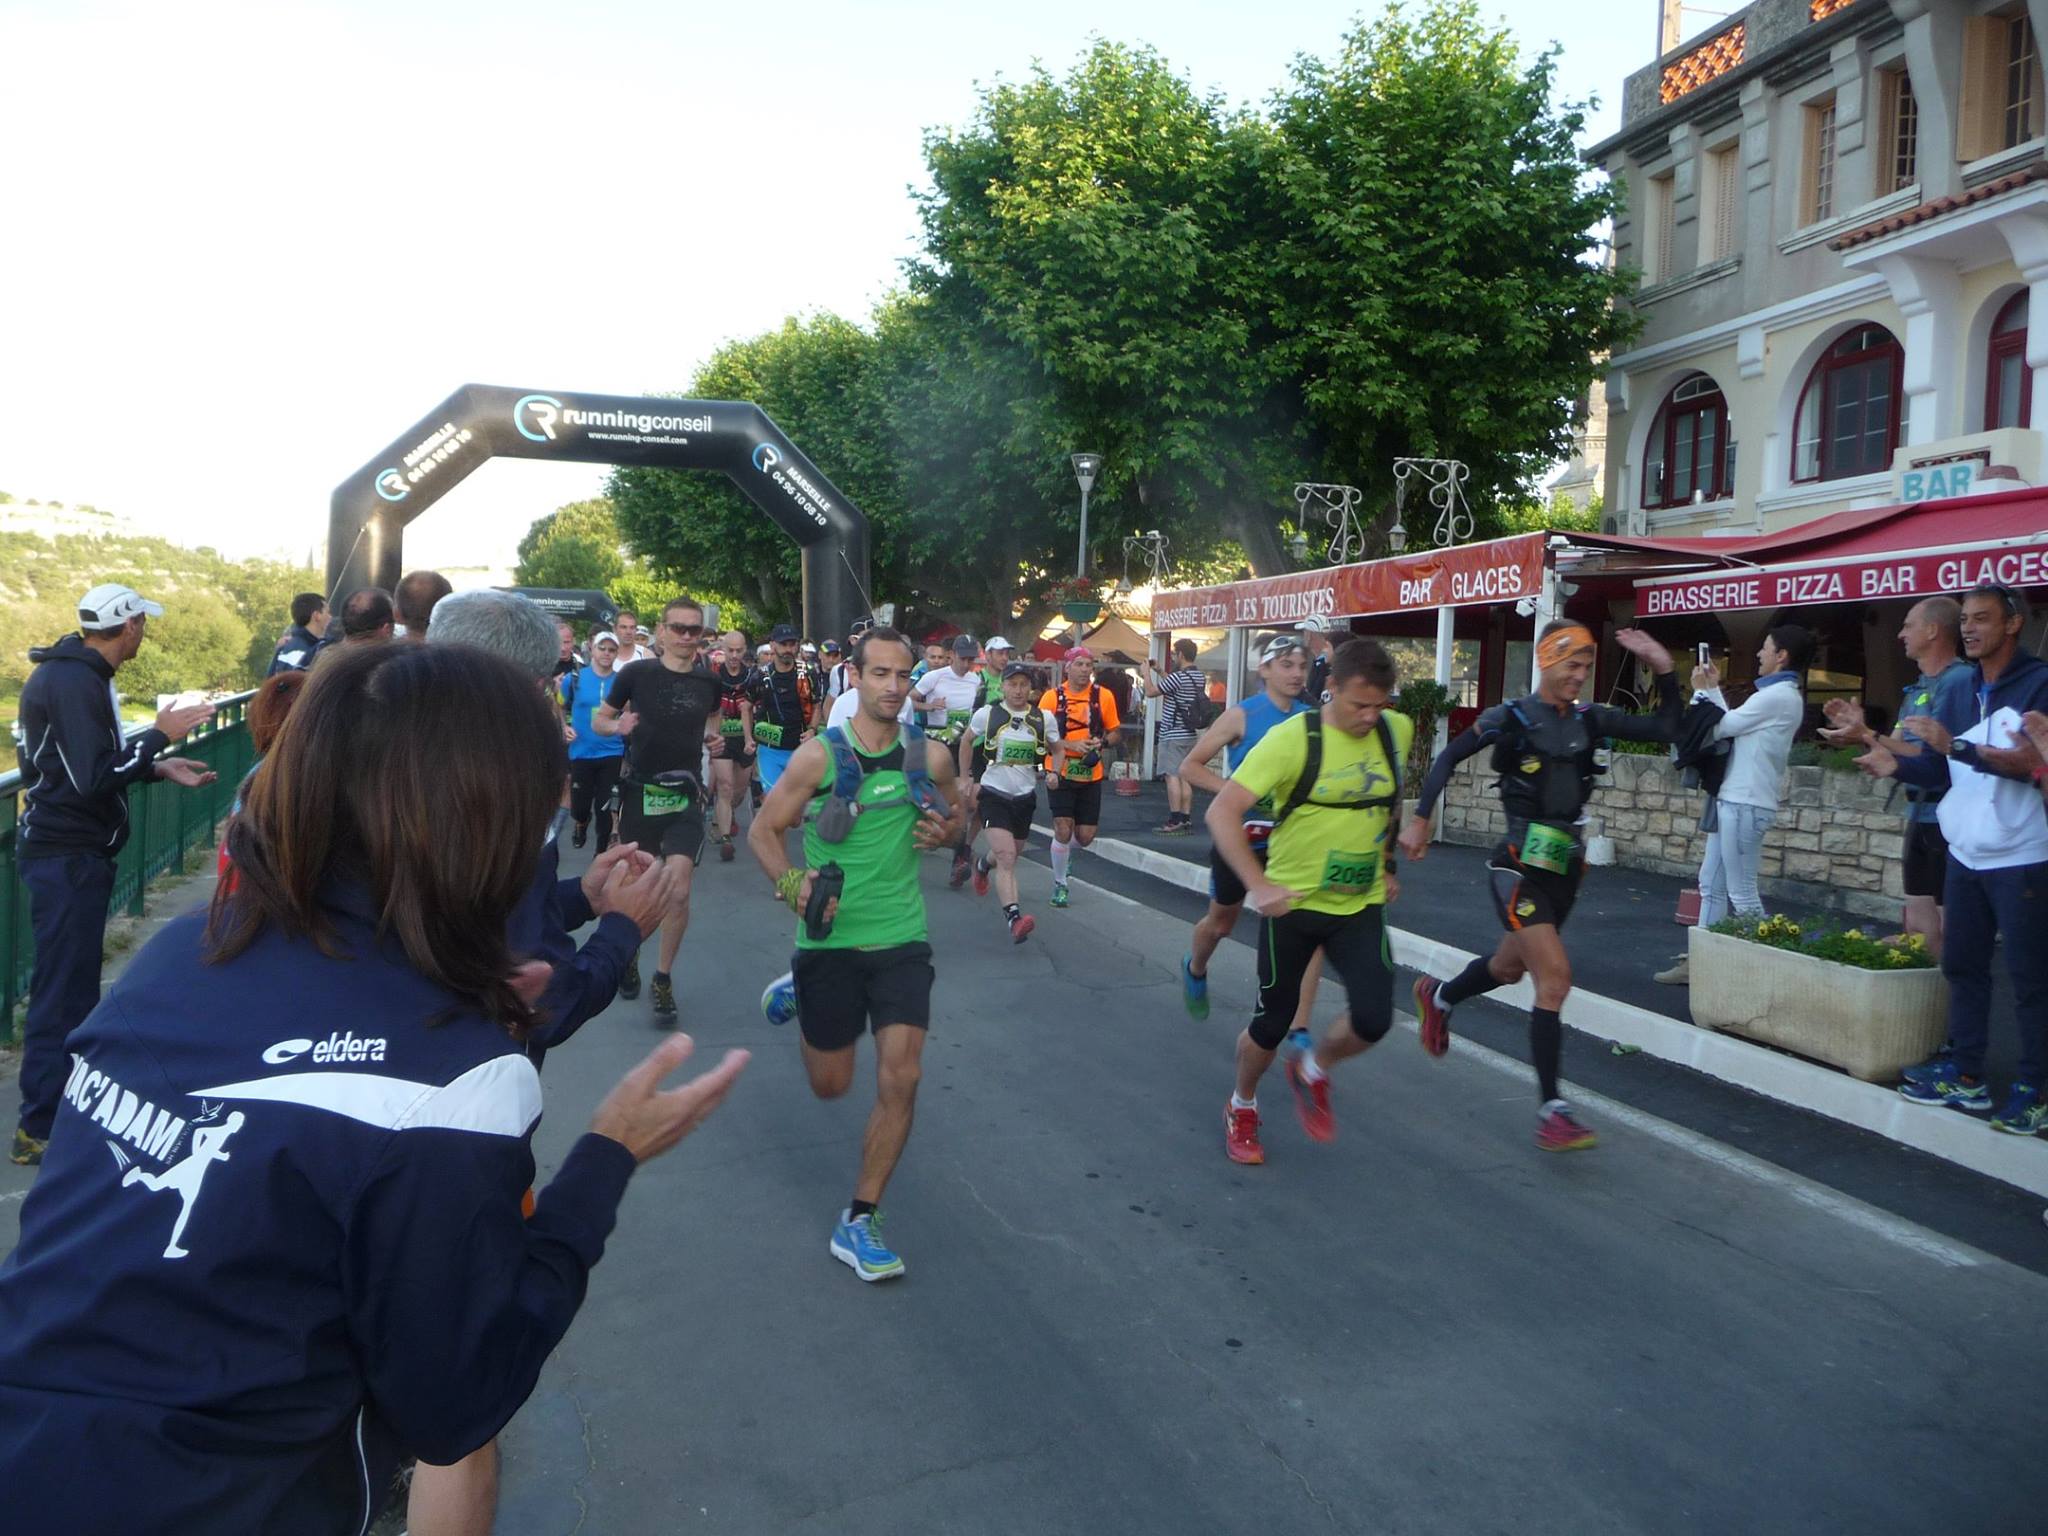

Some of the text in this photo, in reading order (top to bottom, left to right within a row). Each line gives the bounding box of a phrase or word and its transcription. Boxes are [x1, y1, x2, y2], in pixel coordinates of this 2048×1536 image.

[563, 409, 712, 433] runningconseil
[588, 432, 688, 445] www.running-conseil.com
[772, 471, 827, 526] 04 96 10 08 10
[786, 467, 831, 512] MARSEILLE
[1903, 465, 1971, 502] BAR
[1400, 564, 1521, 605] BAR GLACES
[1648, 581, 1759, 613] BRASSERIE
[1776, 573, 1844, 603] PIZZA
[1861, 566, 1916, 596] BAR
[1154, 587, 1334, 629] BRASSERIE PIZZA LES TOURISTES
[756, 727, 779, 742] 2012
[1006, 747, 1033, 759] 2276
[312, 1031, 387, 1063] eldera
